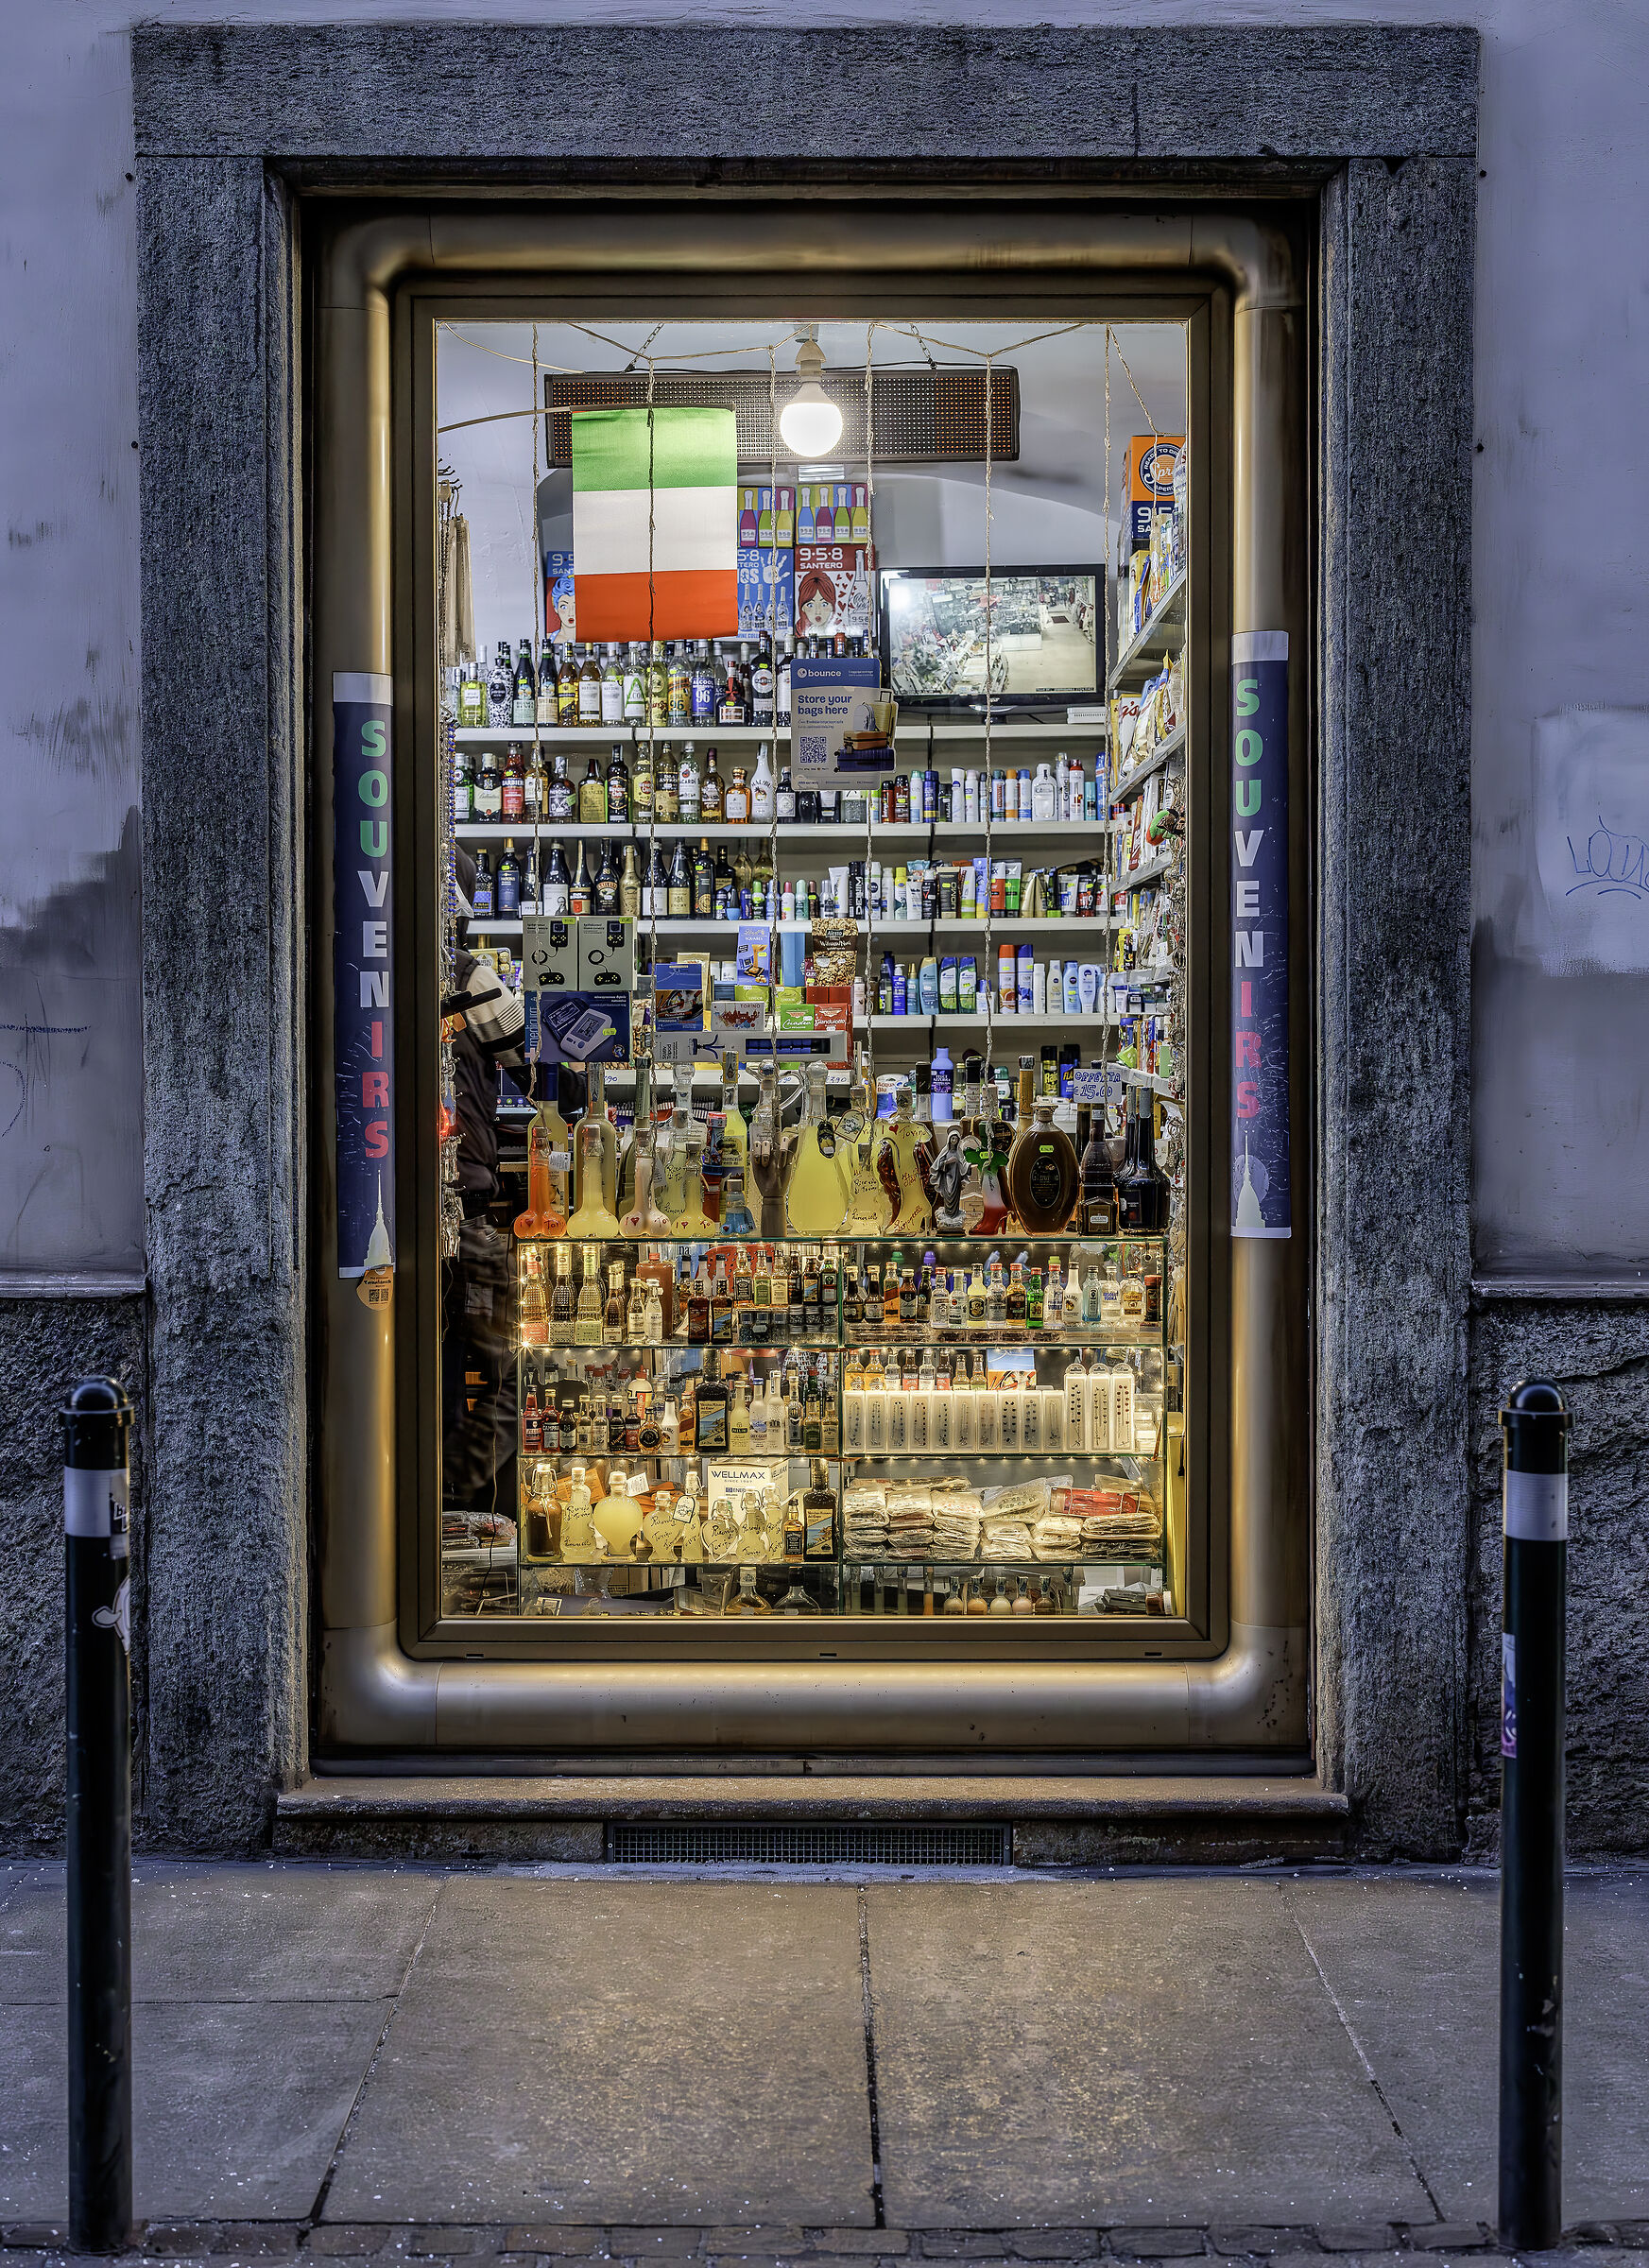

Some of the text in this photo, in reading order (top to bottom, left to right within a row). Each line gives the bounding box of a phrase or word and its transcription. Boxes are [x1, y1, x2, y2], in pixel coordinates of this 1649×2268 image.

[696, 689, 711, 703] 96
[798, 695, 852, 705] Store your
[798, 706, 849, 716] bags here
[1234, 678, 1264, 1119] SOUVENIRS
[357, 719, 390, 1159] SOUVENIRS
[711, 1470, 765, 1480] WELLMAX
